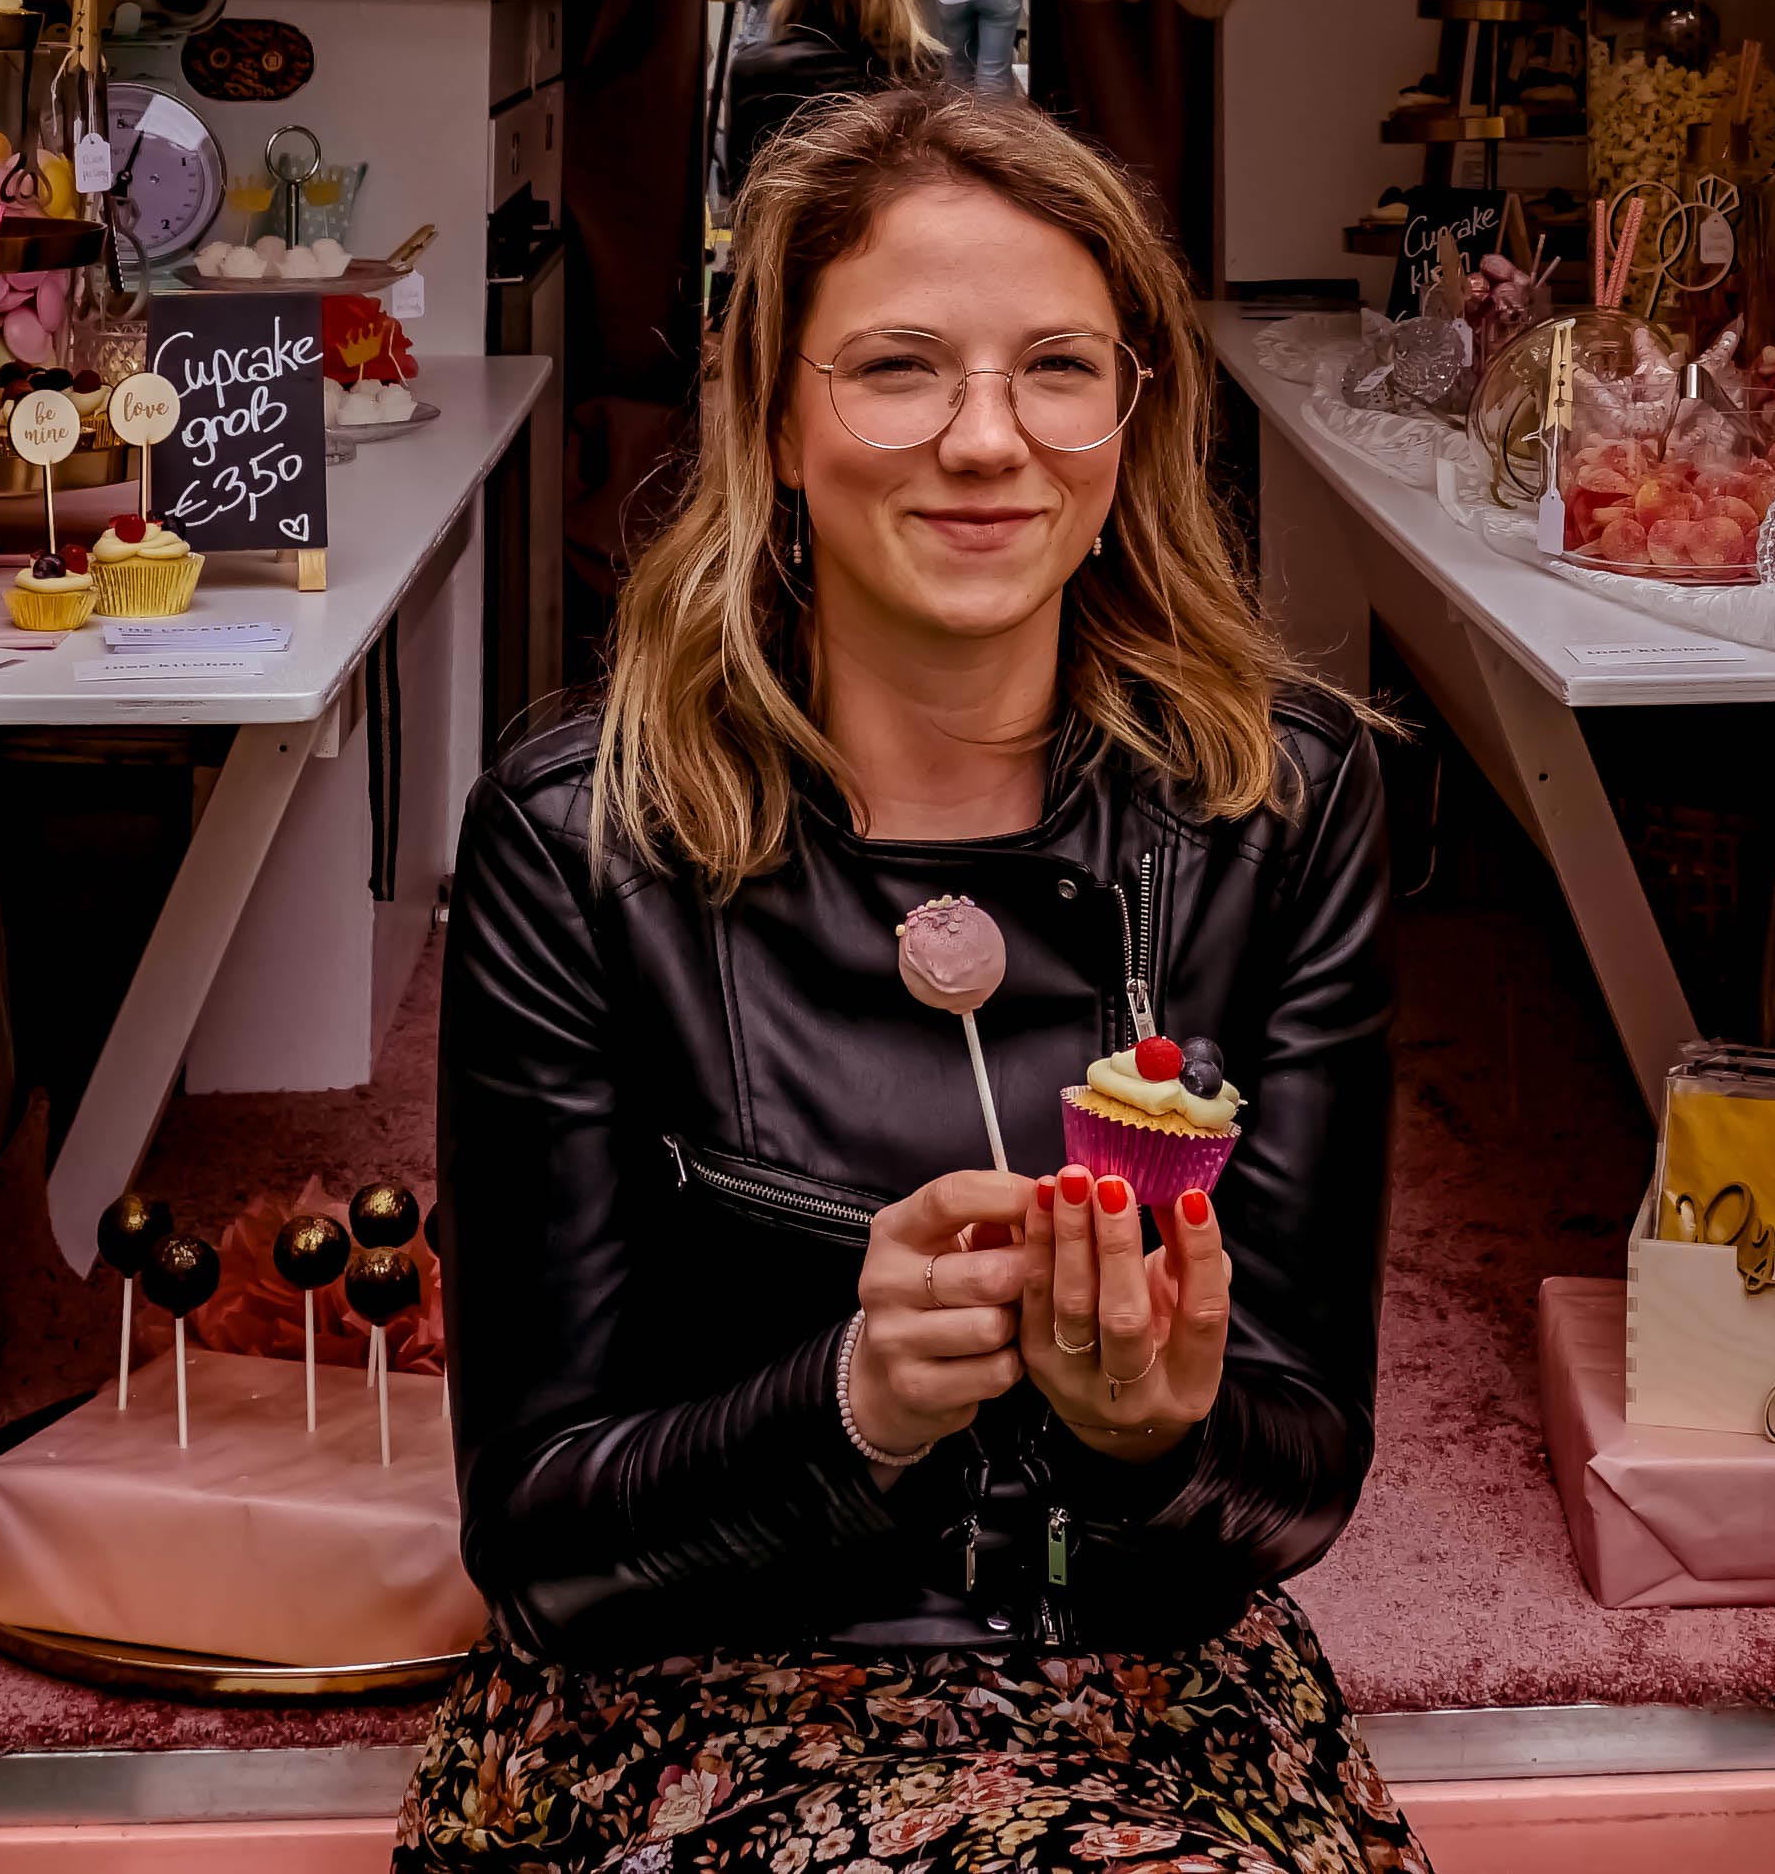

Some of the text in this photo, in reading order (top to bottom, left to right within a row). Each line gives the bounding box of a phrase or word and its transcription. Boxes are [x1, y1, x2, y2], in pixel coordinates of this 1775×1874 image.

[1410, 251, 1471, 295] klen
[153, 316, 324, 408] Cupcake
[34, 401, 56, 426] be
[123, 391, 170, 422] love
[24, 426, 70, 446] mine
